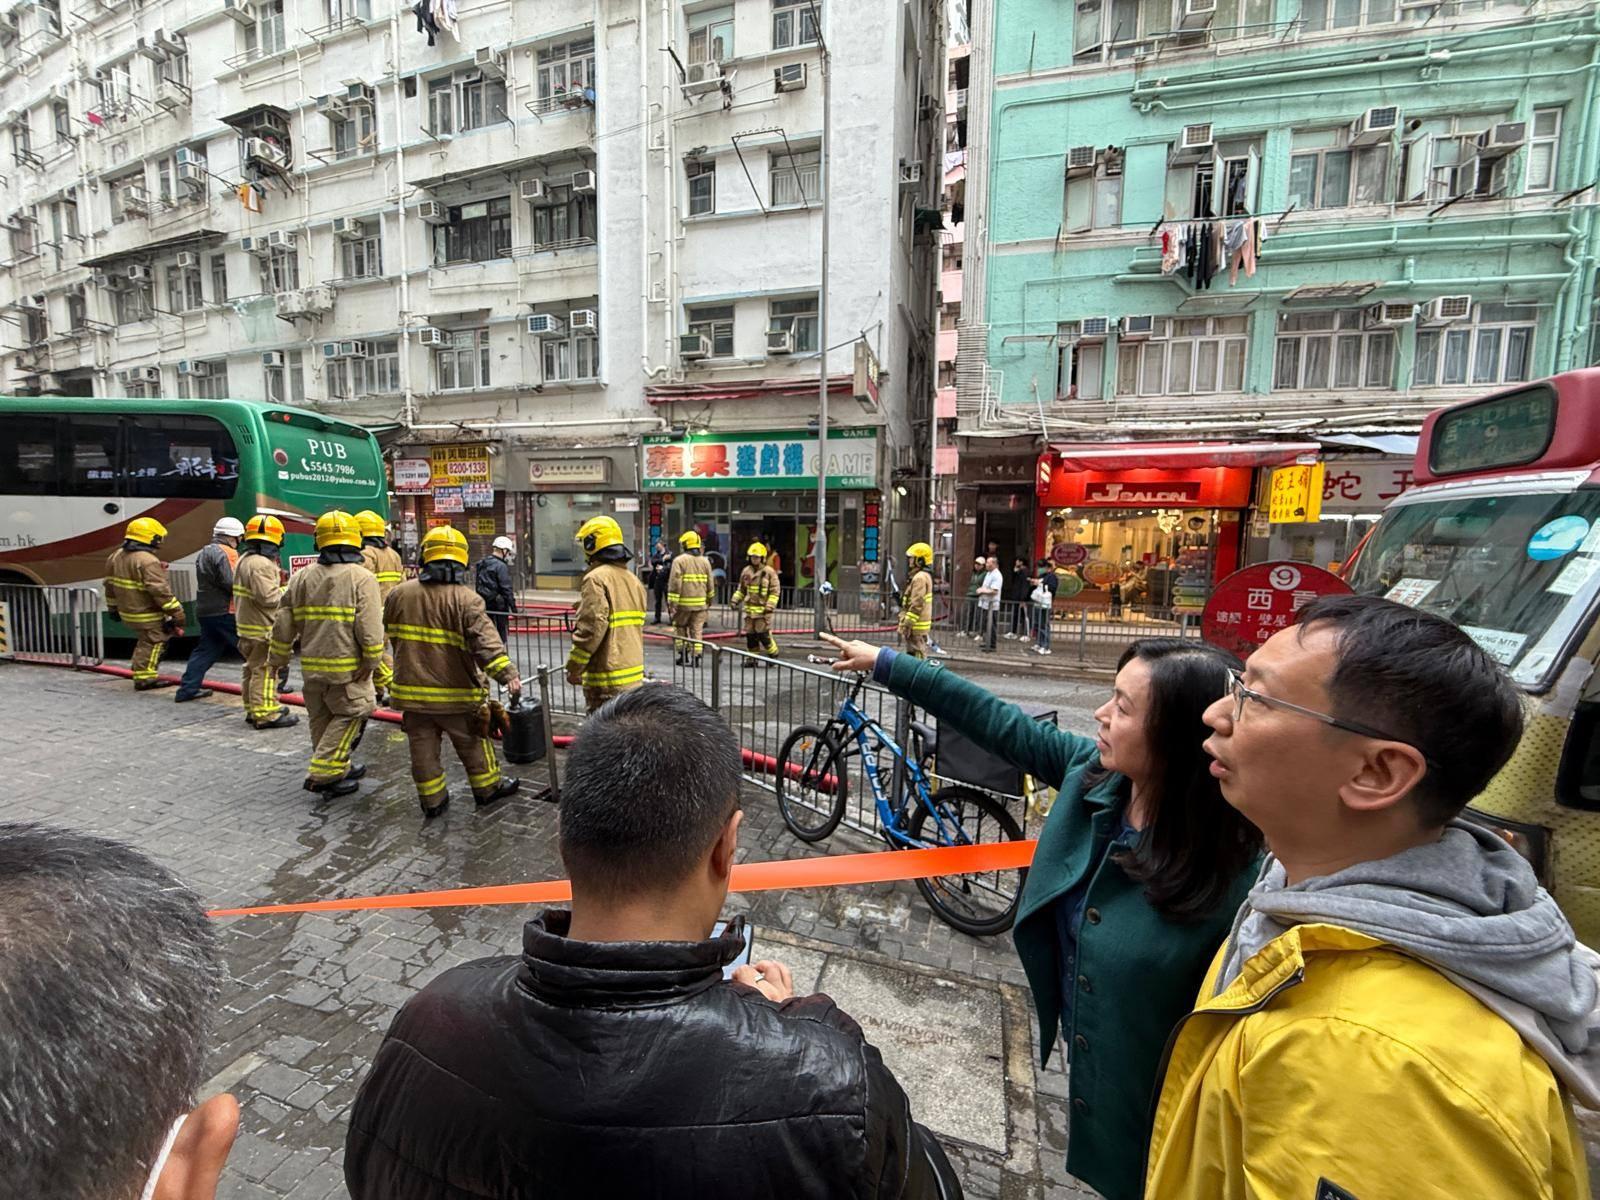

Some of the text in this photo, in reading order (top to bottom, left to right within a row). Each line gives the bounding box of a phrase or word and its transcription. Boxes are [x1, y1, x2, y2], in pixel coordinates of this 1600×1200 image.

[307, 439, 347, 459] PUB
[310, 461, 355, 475] 5543 7986
[810, 453, 874, 476] GAME
[649, 480, 677, 488] APPLE
[841, 477, 870, 485] GAME
[1276, 569, 1294, 586] 9
[1248, 588, 1317, 612] 西貢
